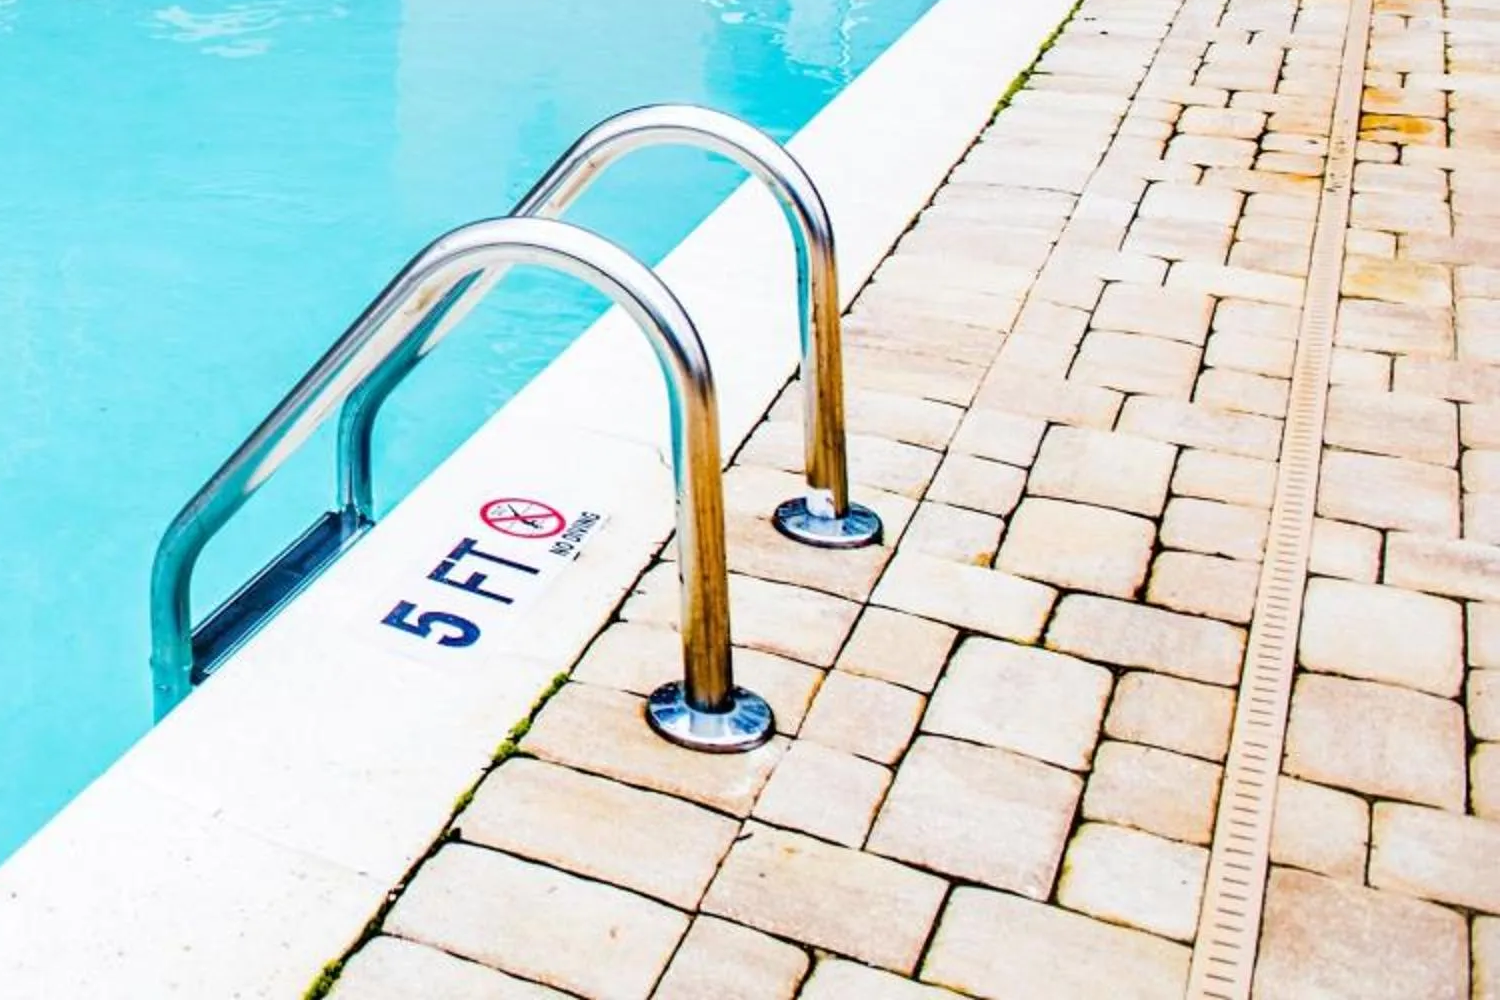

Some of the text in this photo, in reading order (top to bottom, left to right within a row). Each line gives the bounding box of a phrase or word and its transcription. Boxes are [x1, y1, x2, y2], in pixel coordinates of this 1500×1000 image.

[548, 511, 601, 557] NO DIVING
[381, 537, 541, 648] 5 FT
